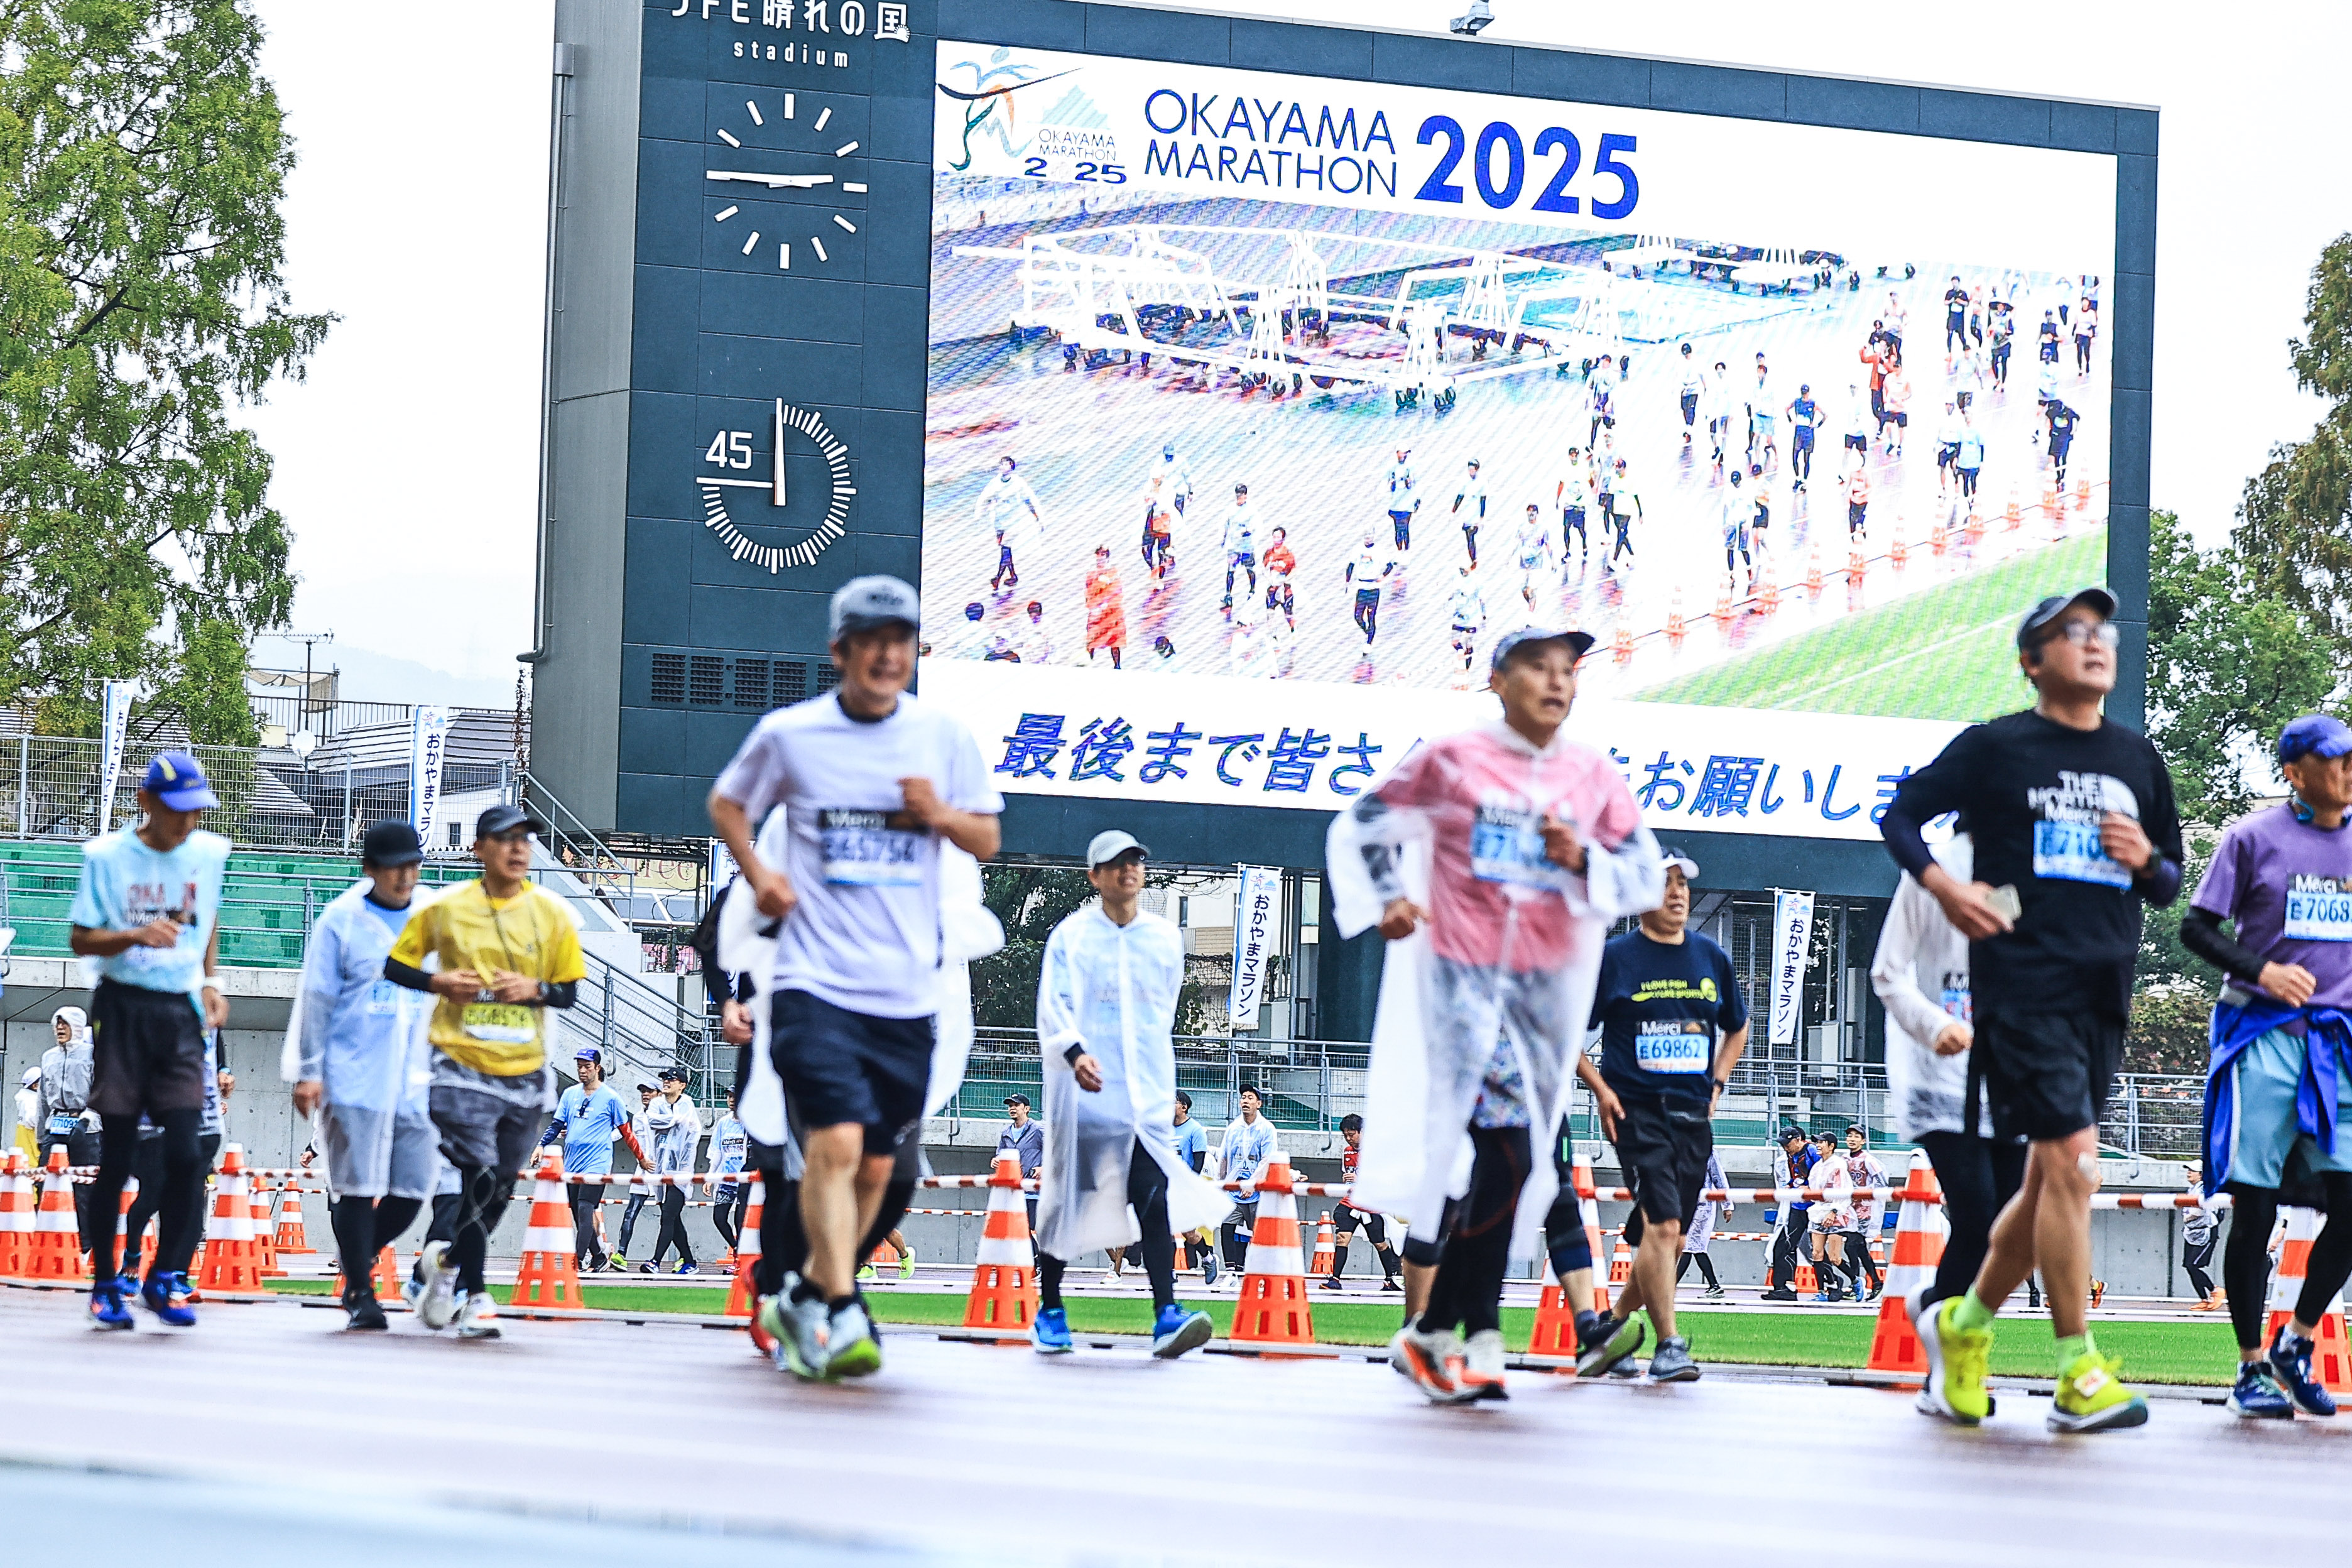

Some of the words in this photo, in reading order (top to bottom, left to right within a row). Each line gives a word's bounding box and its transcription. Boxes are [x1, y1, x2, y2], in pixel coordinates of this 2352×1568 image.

[734, 41, 848, 67] stadium
[1145, 89, 1396, 155] OKAYAMA
[1038, 129, 1116, 148] OKAYAMA
[1038, 144, 1116, 161] MARATHON
[1145, 139, 1396, 197] MARATHON
[1414, 115, 1640, 219] 2025
[705, 430, 753, 469] 45
[2295, 873, 2337, 895] Merci
[2290, 897, 2352, 923] E7068
[1238, 894, 1270, 1017] おかやまマラソン
[1777, 918, 1804, 1038] おかやまマラソン
[1642, 1020, 1681, 1036] Merci
